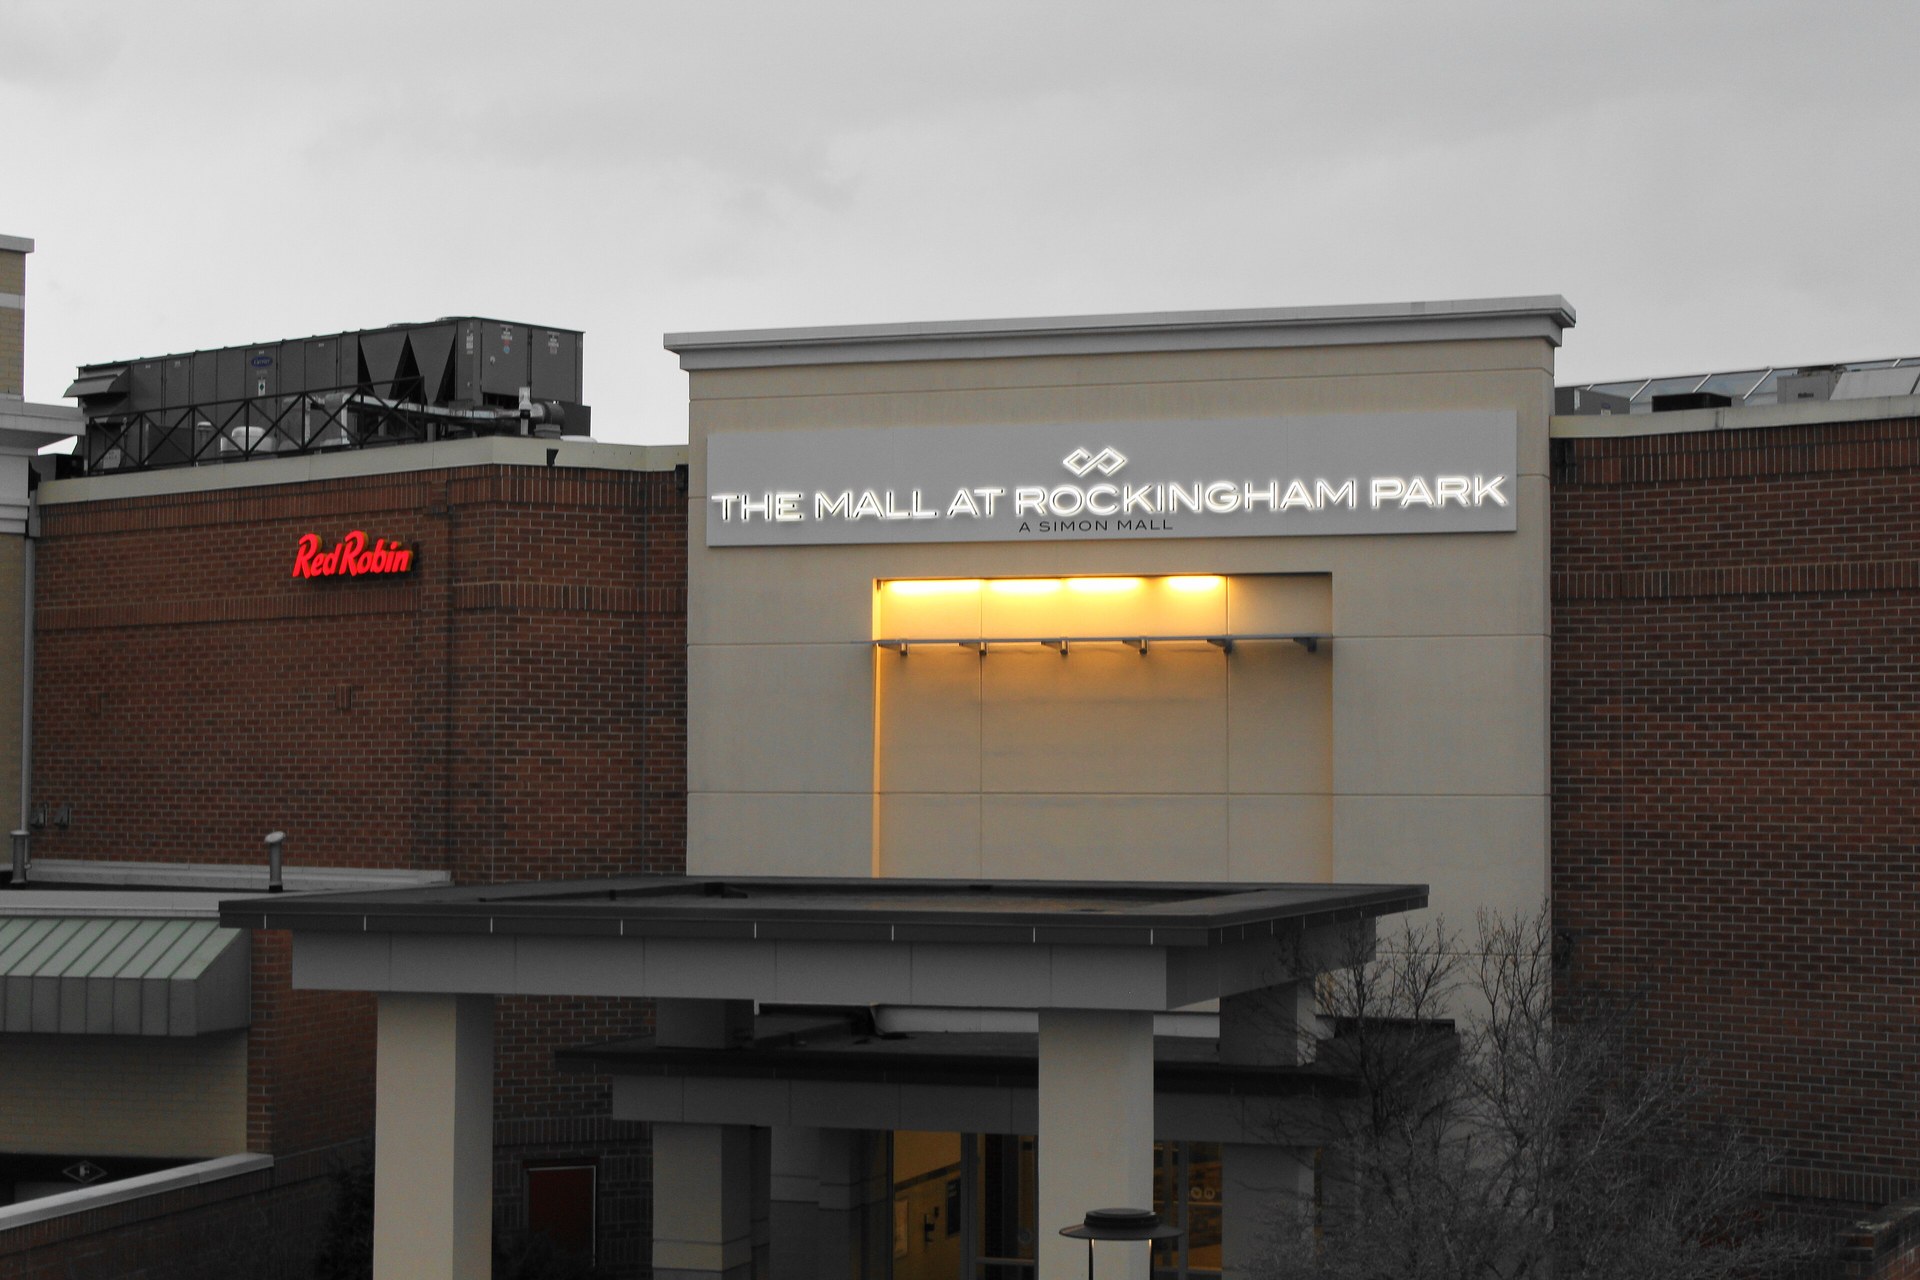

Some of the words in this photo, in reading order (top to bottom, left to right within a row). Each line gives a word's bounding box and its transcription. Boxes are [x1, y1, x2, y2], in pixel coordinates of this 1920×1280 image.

[711, 493, 803, 521] THE
[815, 490, 938, 520] MALL
[947, 488, 1005, 517] AT
[1015, 480, 1356, 516] ROCKINGHAM
[1371, 475, 1507, 507] PARK
[1018, 521, 1031, 533] A
[1039, 520, 1108, 533] SIMON
[1117, 519, 1173, 531] MALL
[292, 533, 343, 579] Red
[338, 530, 412, 577] Robin
